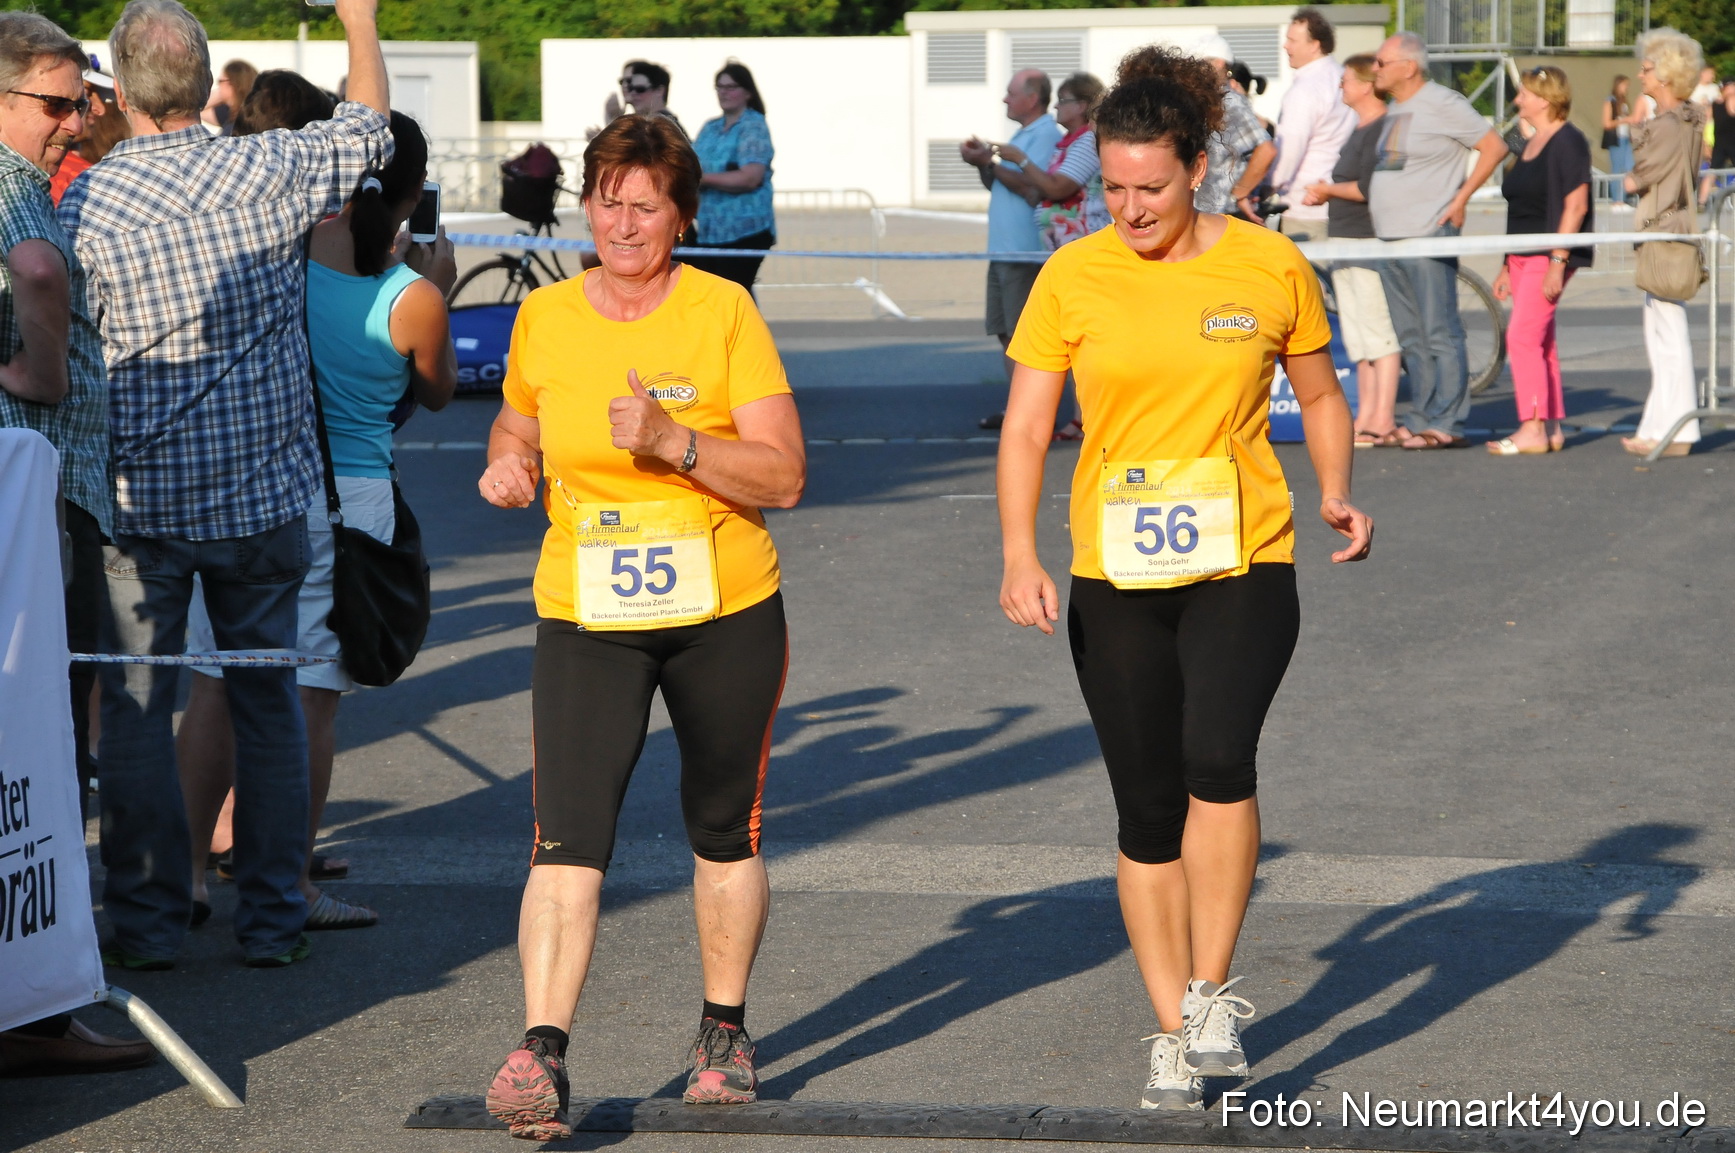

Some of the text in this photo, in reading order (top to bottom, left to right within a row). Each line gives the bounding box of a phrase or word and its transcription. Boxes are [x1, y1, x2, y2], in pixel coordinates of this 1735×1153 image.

[1206, 316, 1242, 332] plank
[1117, 481, 1164, 491] firmenlauf
[591, 523, 640, 534] firmenlauf
[1134, 504, 1199, 556] 56
[1147, 559, 1170, 567] Sonja
[611, 546, 677, 598] 55
[1203, 566, 1225, 574] GmbH
[619, 599, 675, 608] Theresia Zeller
[622, 611, 659, 619] Konditorei
[681, 606, 704, 614] GmbH
